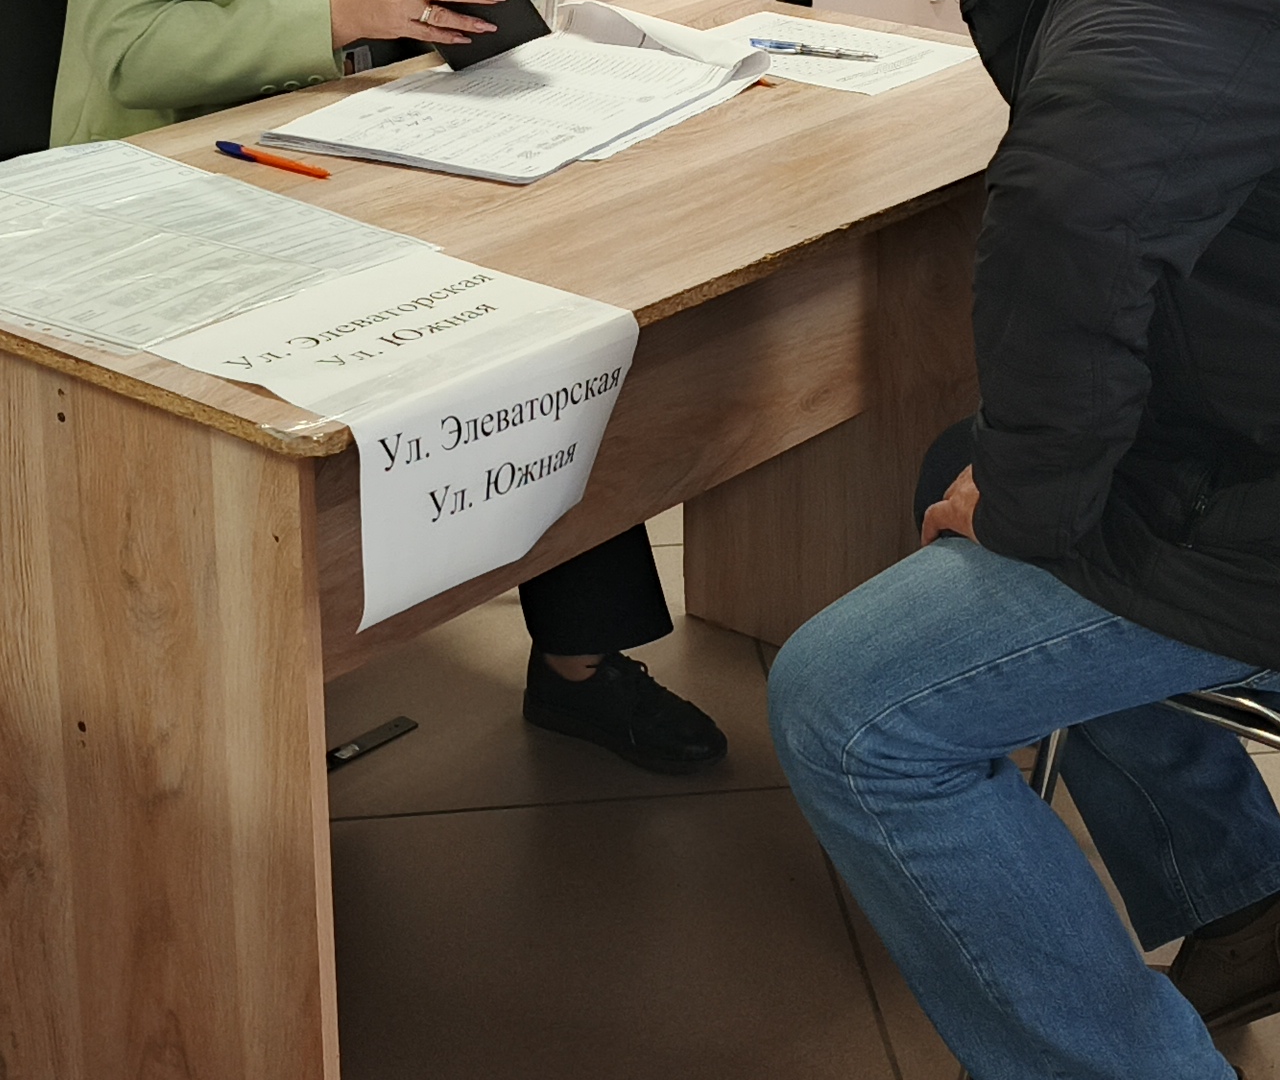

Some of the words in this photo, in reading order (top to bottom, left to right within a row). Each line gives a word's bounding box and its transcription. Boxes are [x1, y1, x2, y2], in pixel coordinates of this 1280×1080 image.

[220, 351, 292, 370] Ул.
[285, 272, 497, 350] Элеваторская
[315, 350, 384, 366] Ул.
[376, 302, 499, 347] Южная
[377, 432, 430, 472] Ул.
[440, 366, 623, 451] Элеваторская
[428, 485, 474, 523] Ул.
[482, 441, 579, 503] Южная
